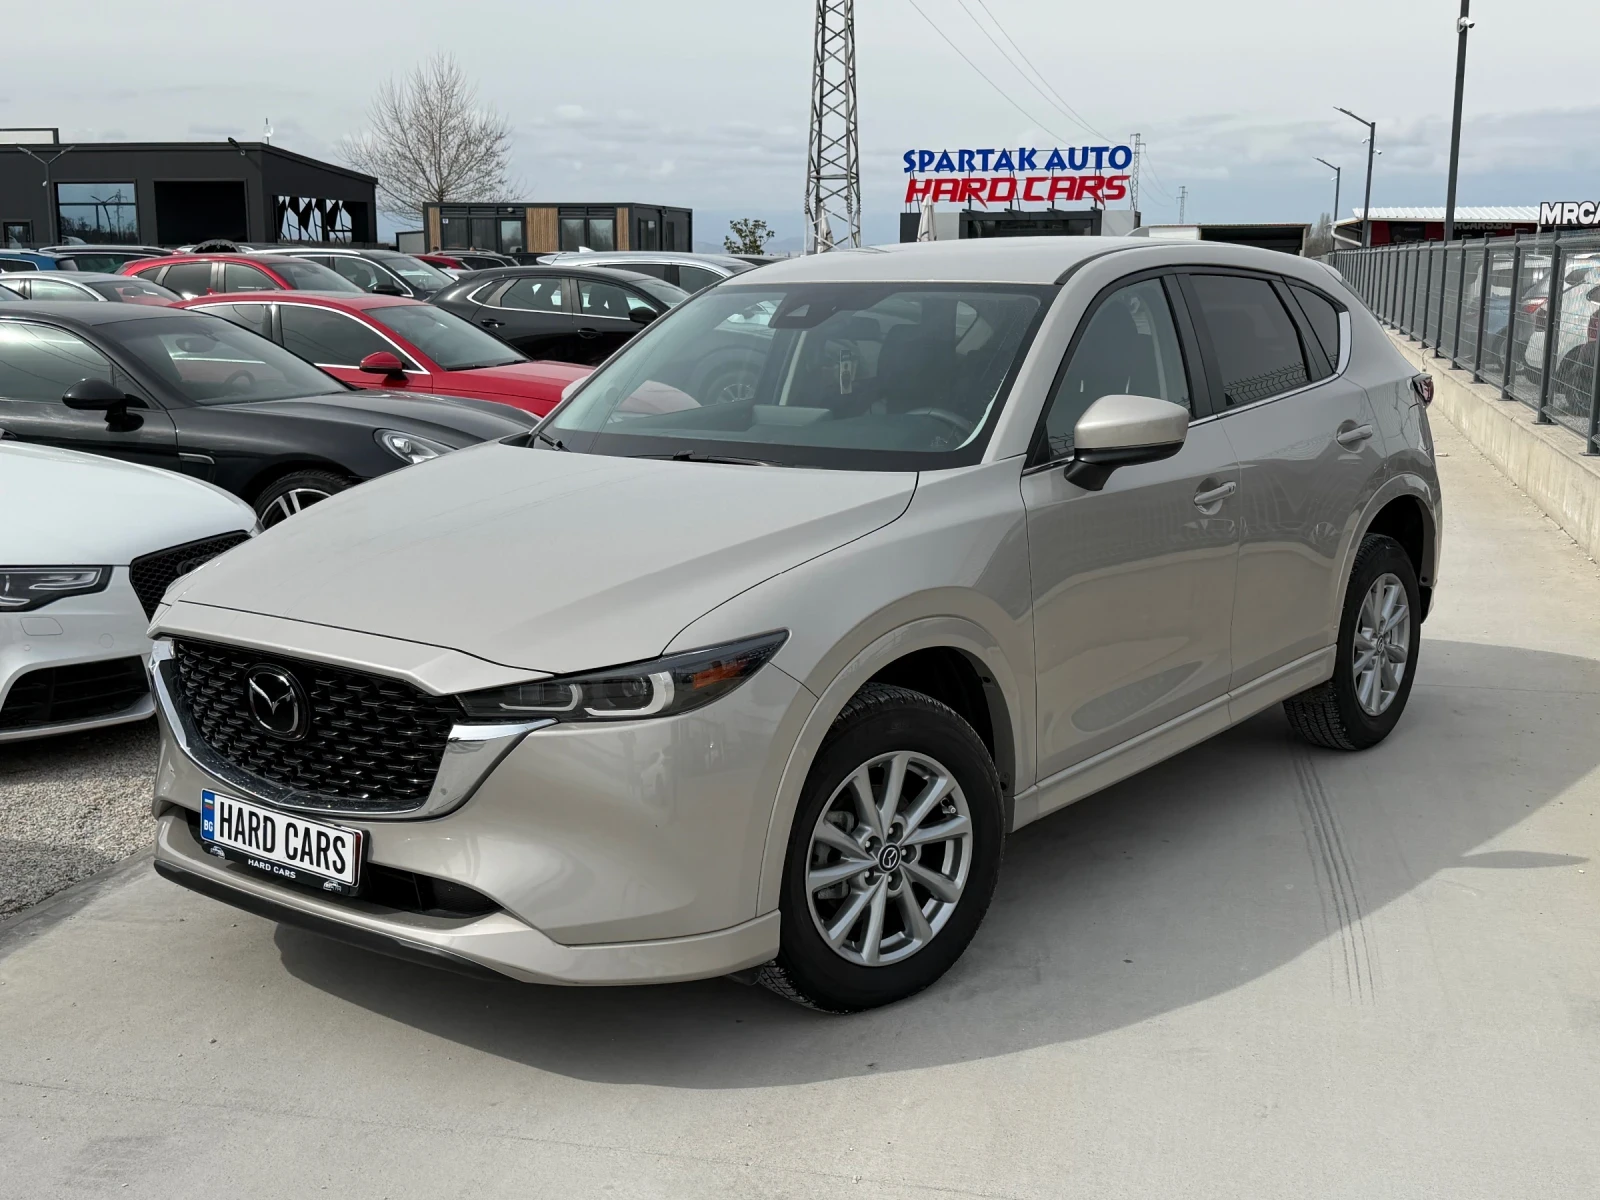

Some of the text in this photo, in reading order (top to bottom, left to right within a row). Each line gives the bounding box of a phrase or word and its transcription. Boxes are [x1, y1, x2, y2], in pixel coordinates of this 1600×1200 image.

[903, 145, 1133, 173] SPARTAK AUTO
[905, 174, 1132, 210] HARD CARS
[203, 819, 214, 832] BG
[219, 801, 346, 875] HARD CARS
[248, 858, 297, 879] HARD CARS
